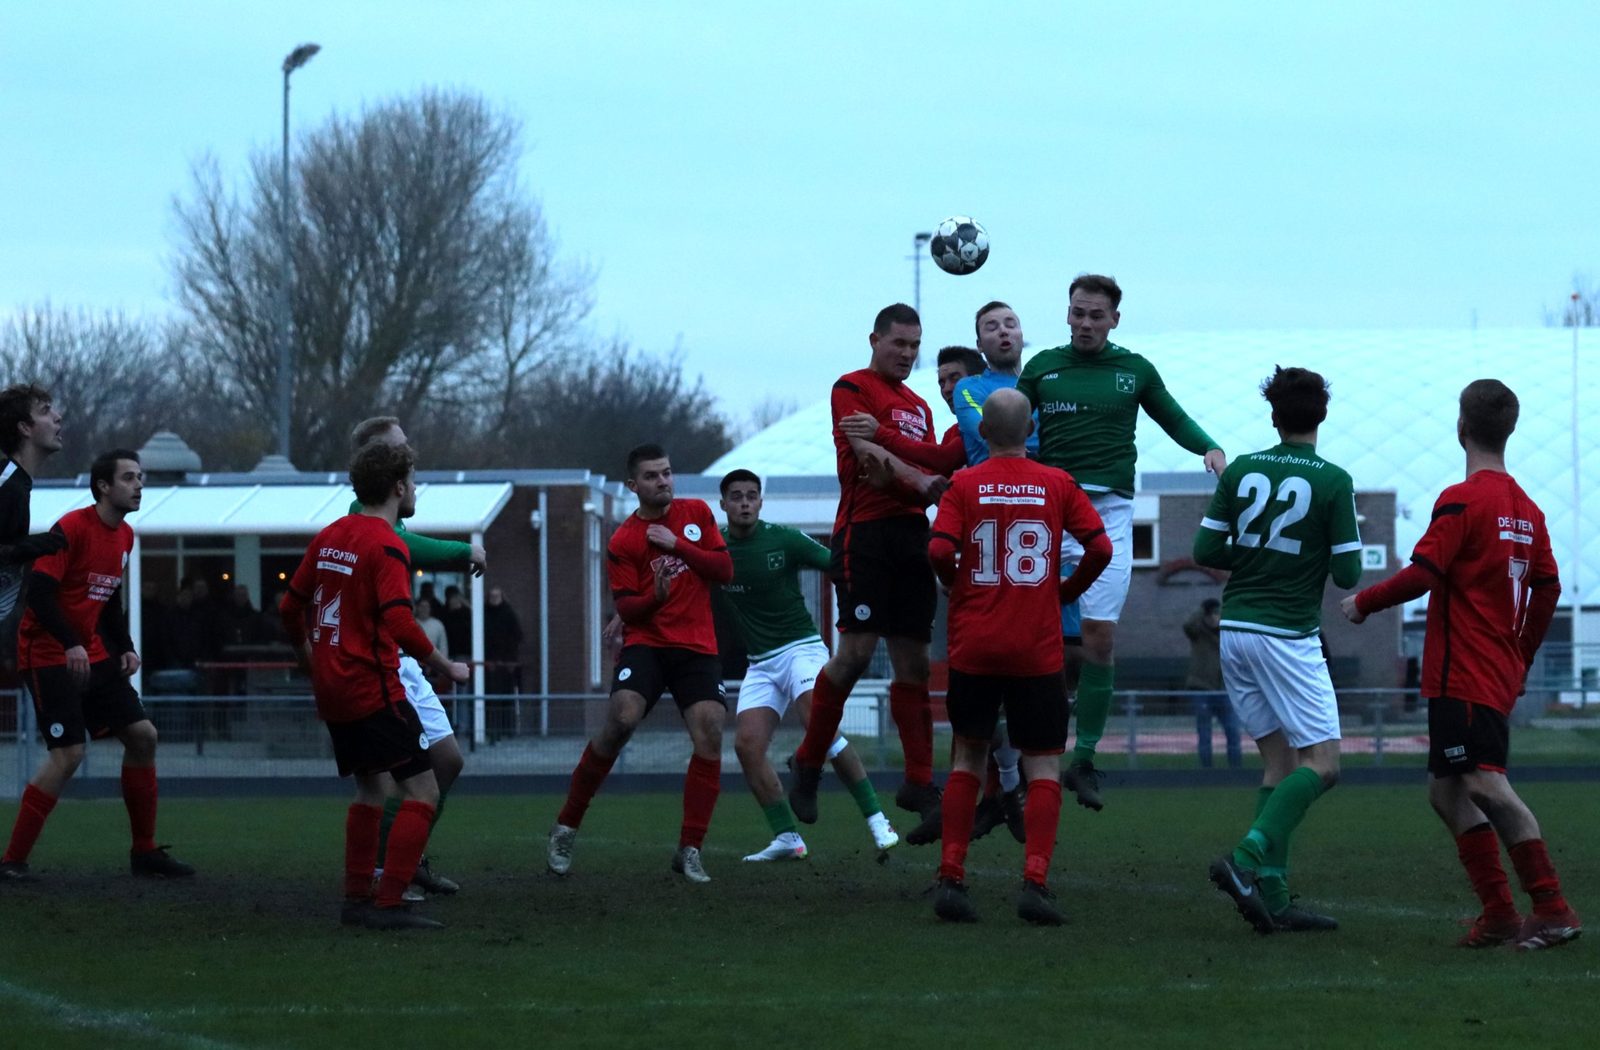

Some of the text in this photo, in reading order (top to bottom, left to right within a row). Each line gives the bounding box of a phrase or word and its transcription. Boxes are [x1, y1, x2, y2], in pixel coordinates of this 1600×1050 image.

[1250, 453, 1326, 470] www.reham.nl
[978, 484, 1046, 496] DE FONTEIN
[1236, 472, 1312, 555] 22
[971, 519, 1052, 587] 18
